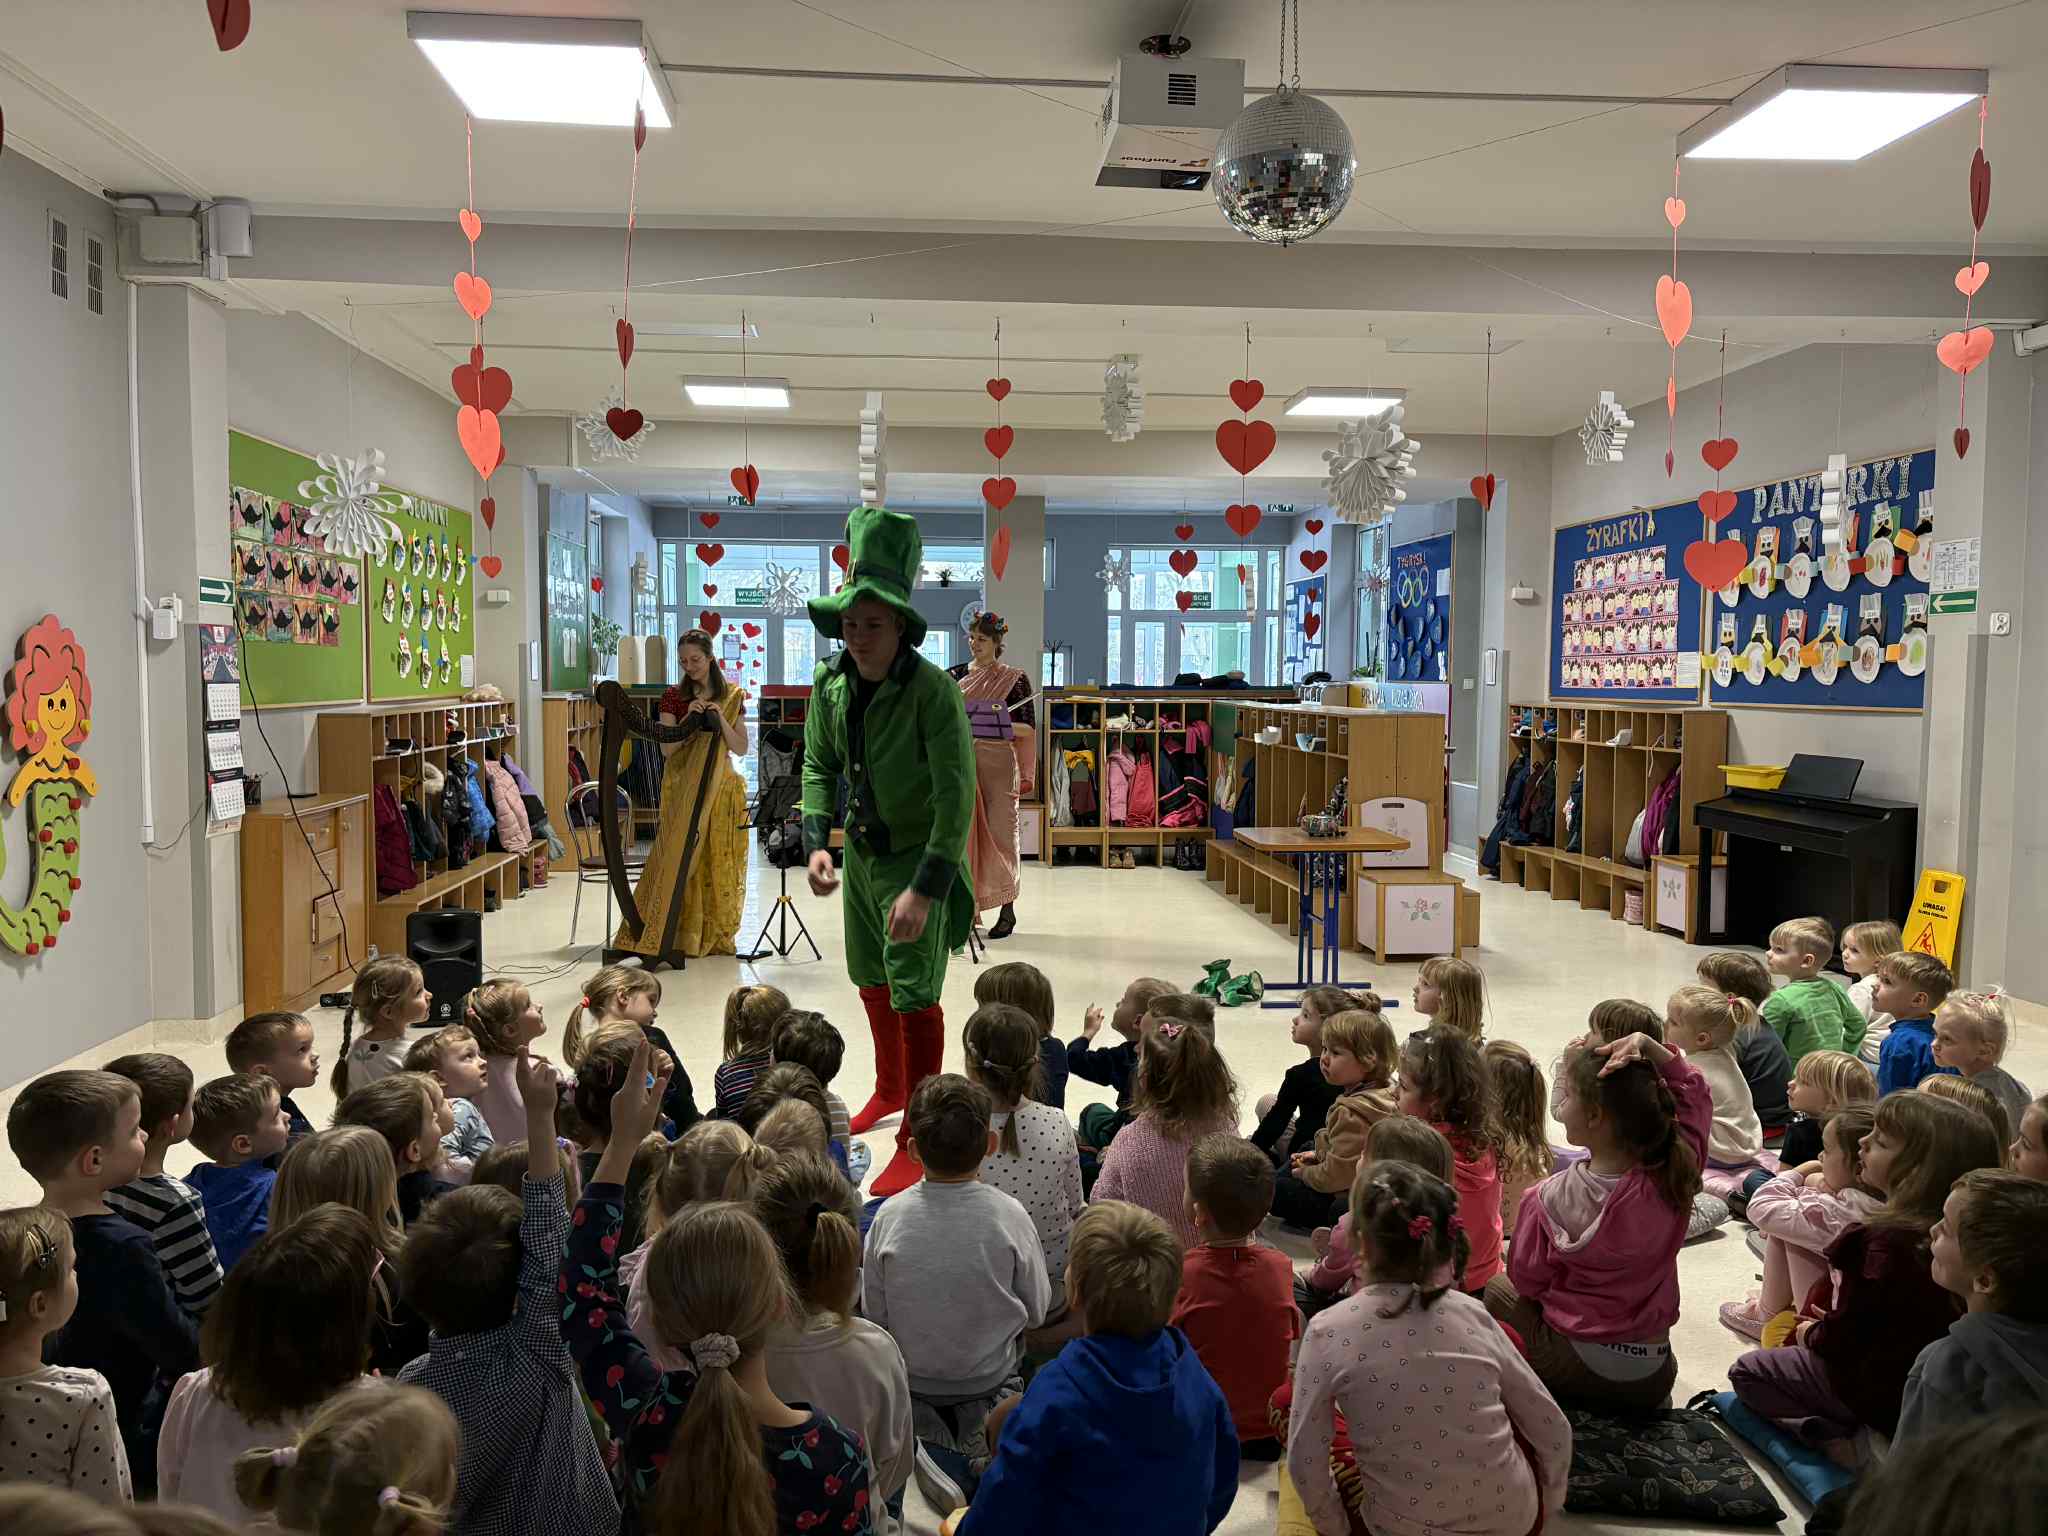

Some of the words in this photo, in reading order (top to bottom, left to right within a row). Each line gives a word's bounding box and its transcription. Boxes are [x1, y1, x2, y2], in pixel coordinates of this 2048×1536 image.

[1752, 455, 1913, 523] PANTRKI
[1586, 514, 1644, 552] ŻYRAFKI
[1922, 902, 1946, 912] UWAGA!
